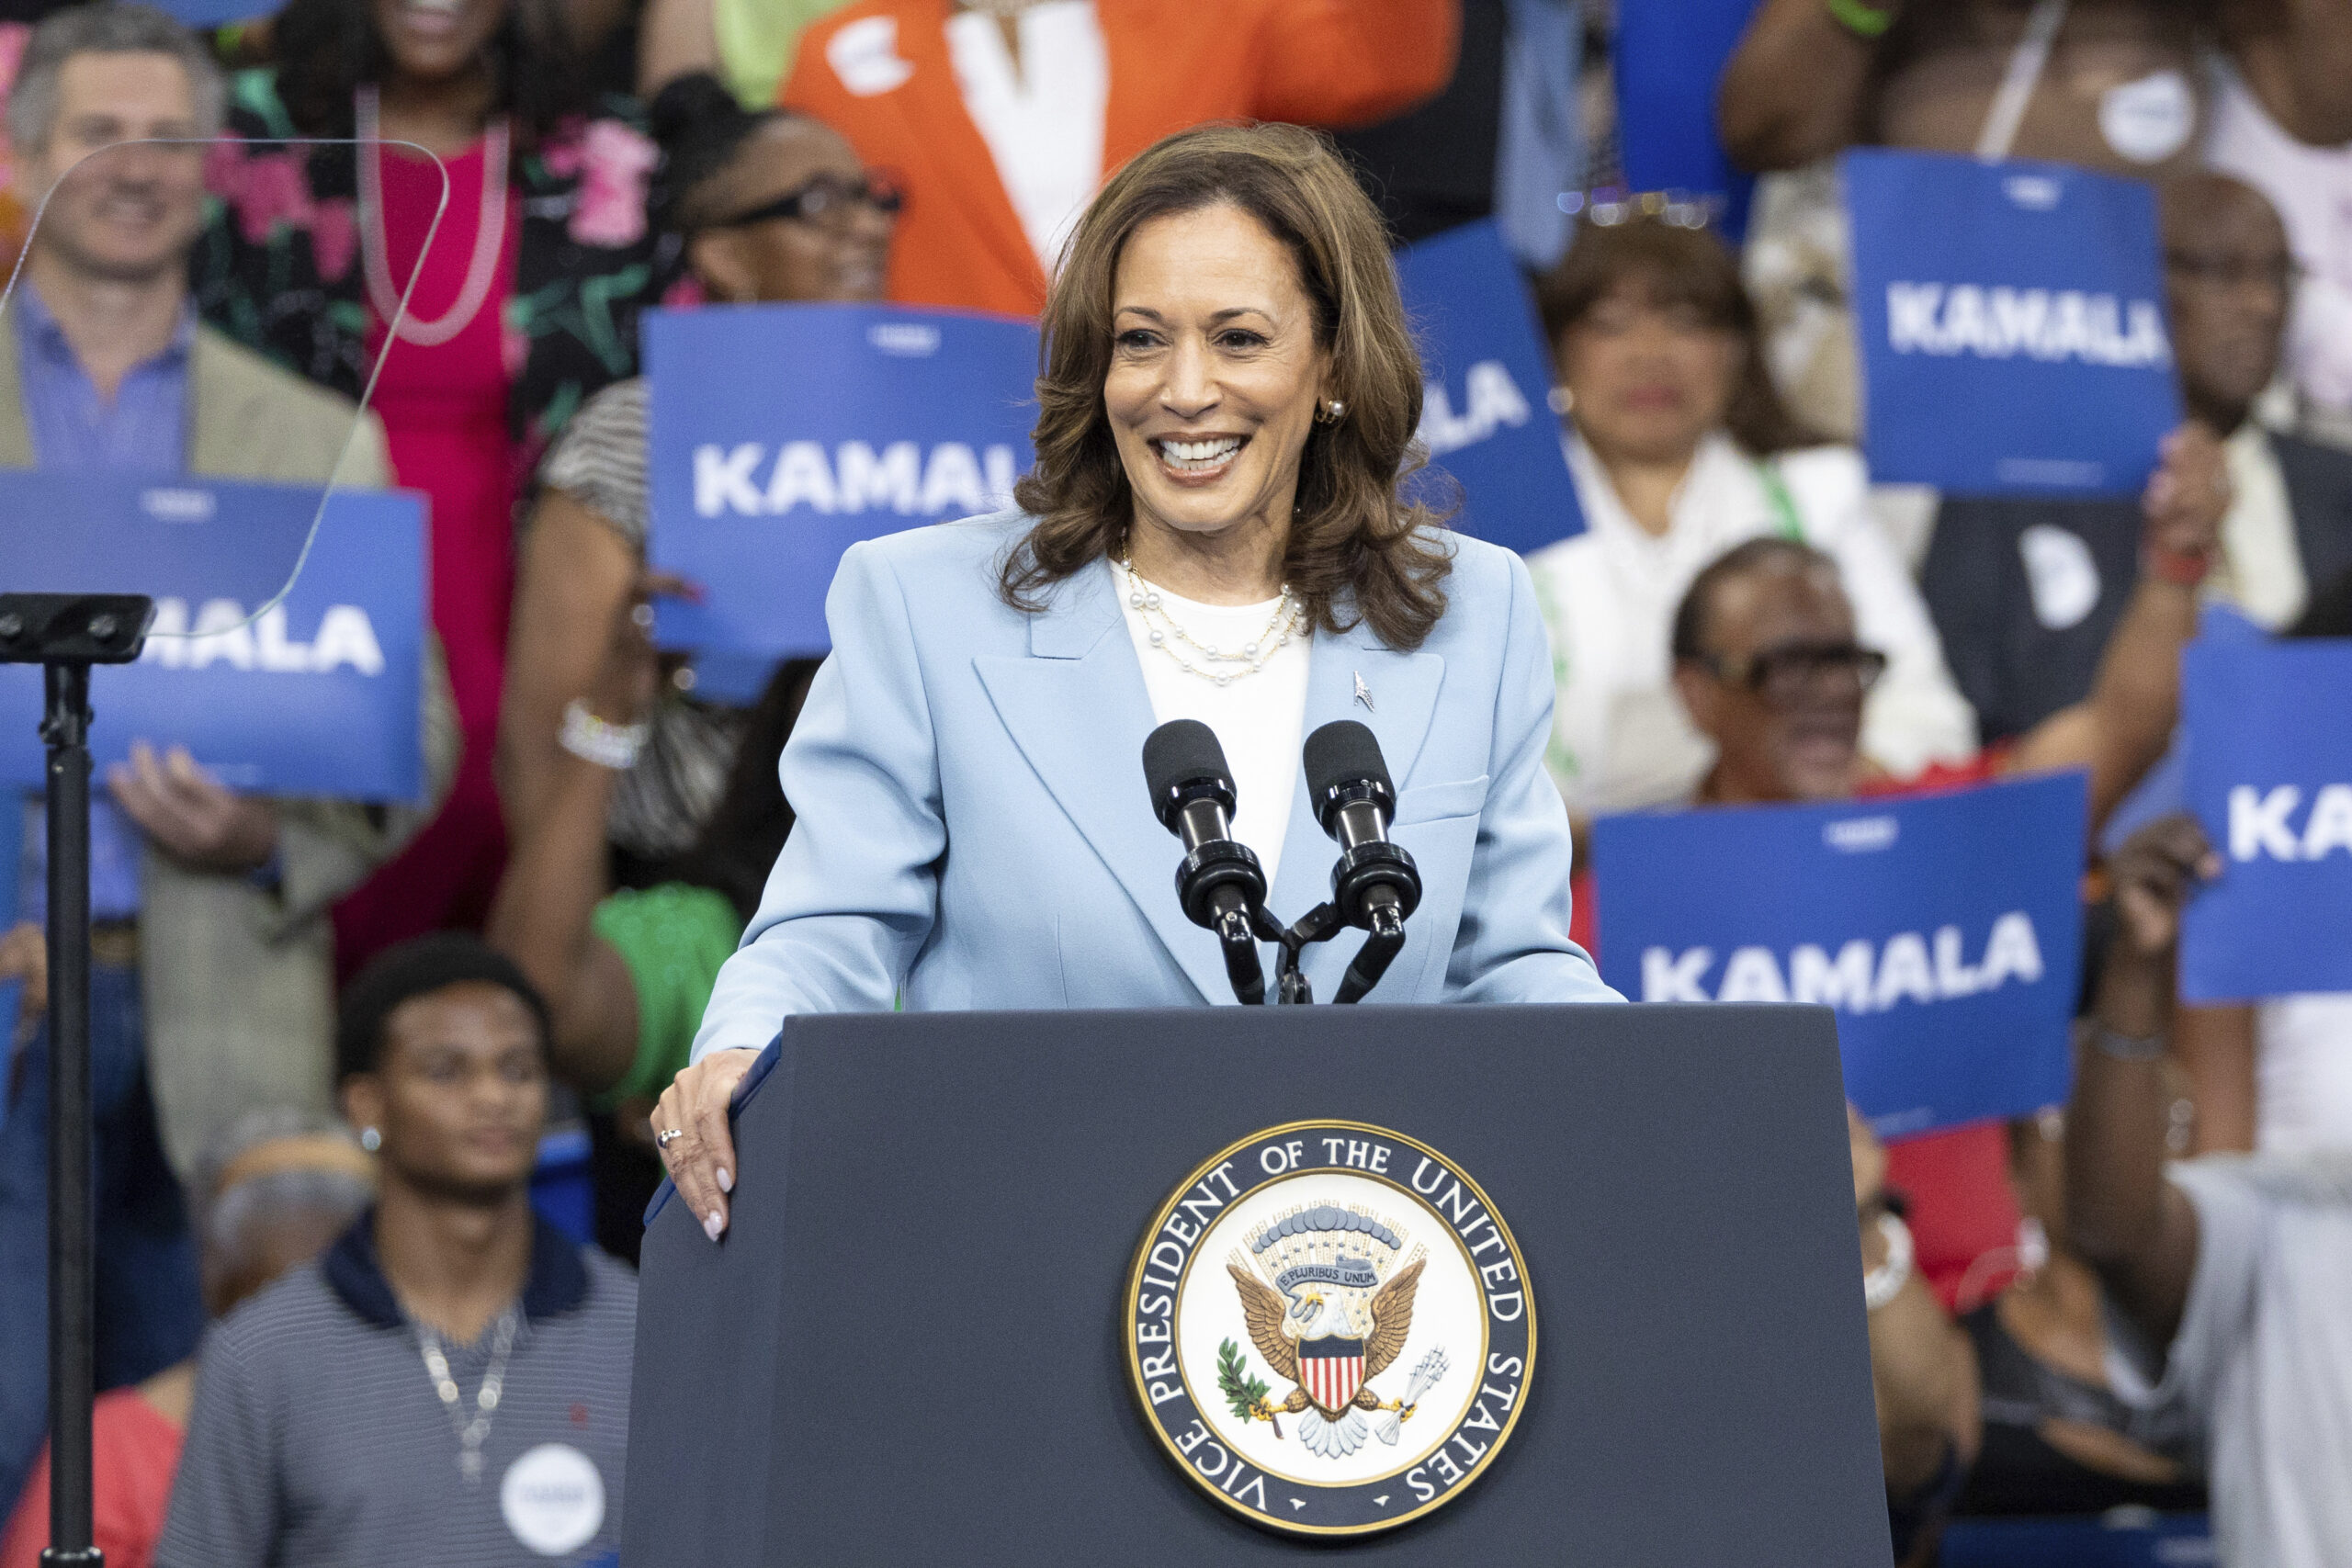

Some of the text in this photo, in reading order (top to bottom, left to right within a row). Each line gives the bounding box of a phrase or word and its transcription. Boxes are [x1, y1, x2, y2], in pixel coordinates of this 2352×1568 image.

[1640, 909, 2043, 1014] KAMALA
[1137, 1137, 1523, 1512] VICE PRESIDENT OF THE UNITED STATES
[1280, 1267, 1376, 1286] E PLURIBUS UNUM
